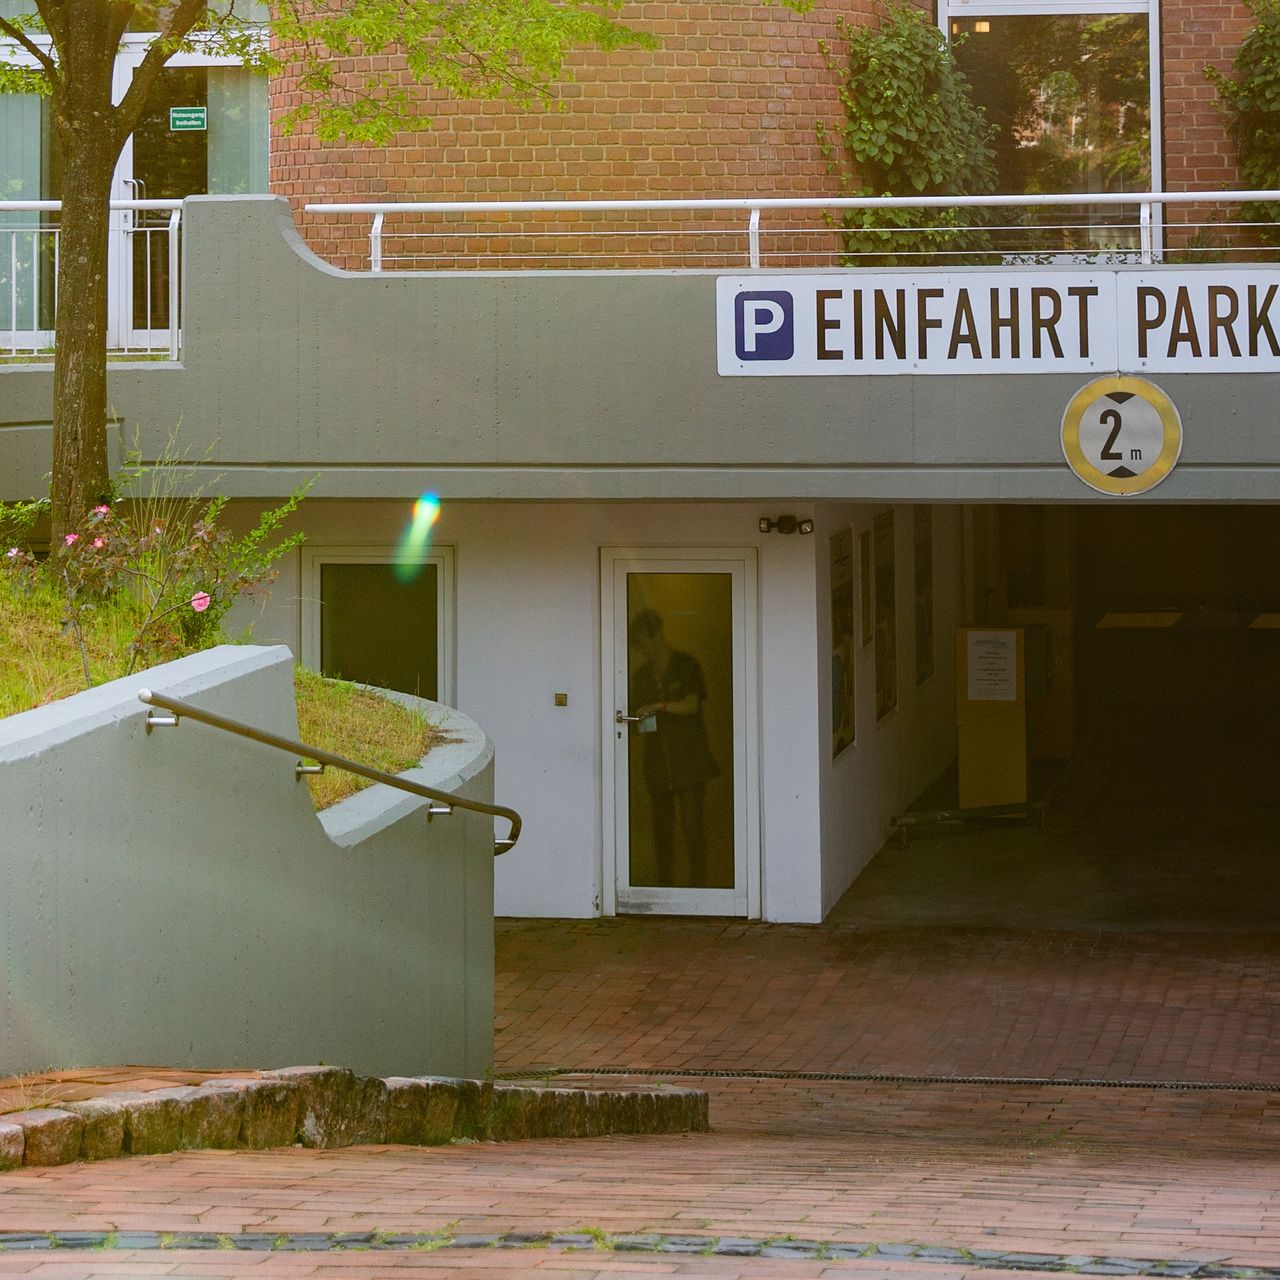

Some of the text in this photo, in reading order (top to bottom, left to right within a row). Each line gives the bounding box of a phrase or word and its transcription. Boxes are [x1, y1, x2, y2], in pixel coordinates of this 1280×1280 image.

[743, 299, 785, 352] P
[816, 286, 1099, 361] EINFAHRT
[1099, 408, 1142, 461] 2 m
